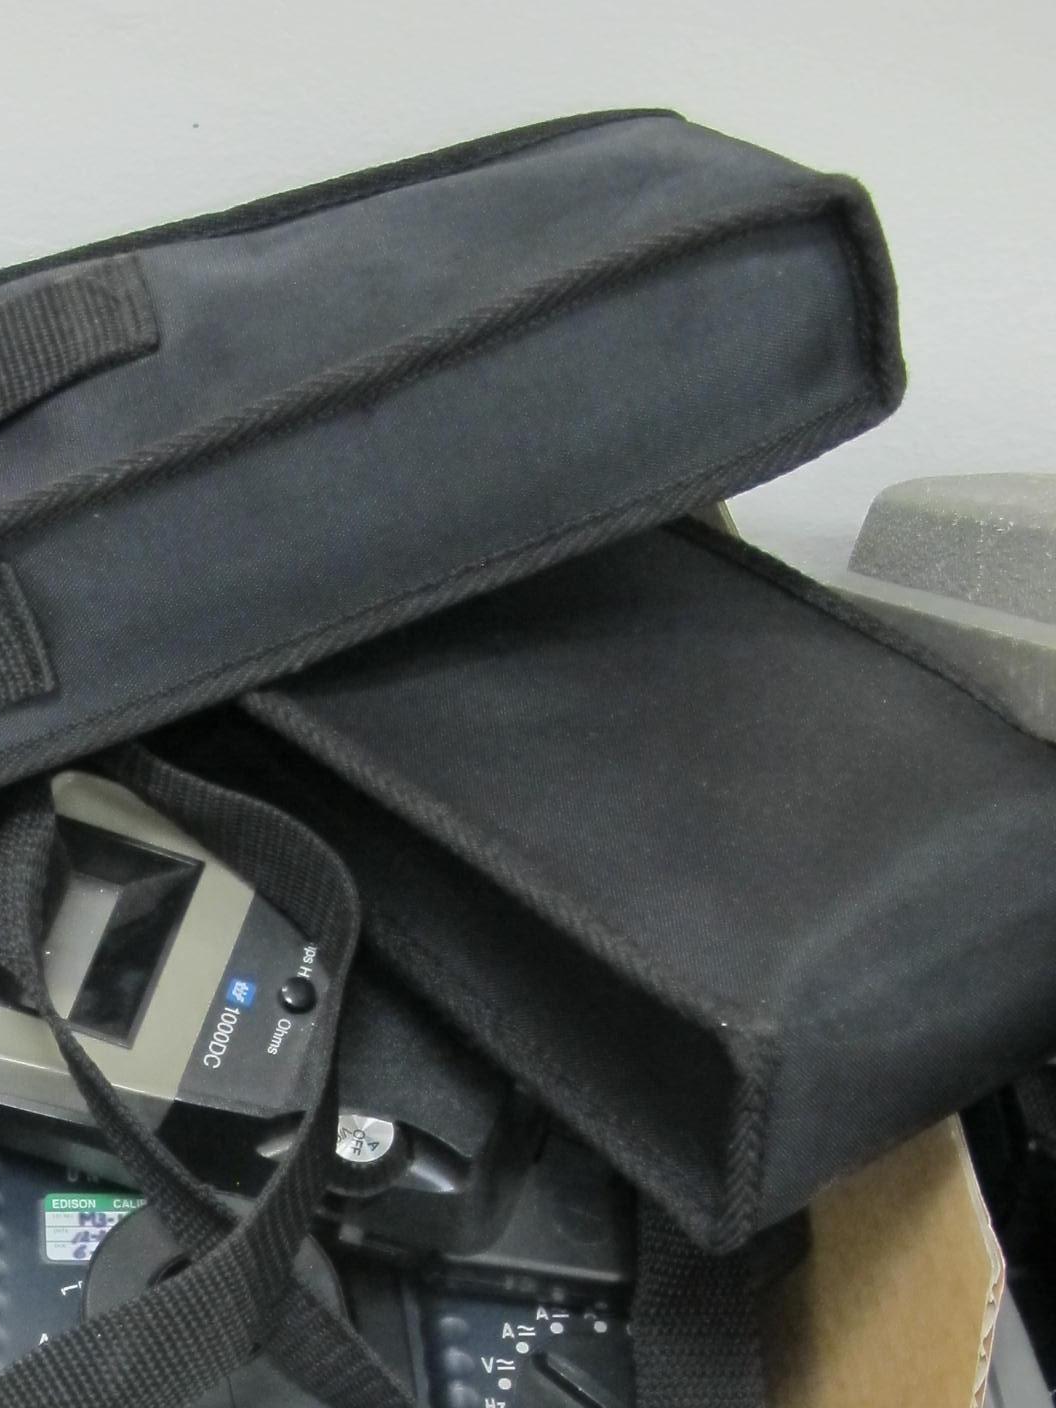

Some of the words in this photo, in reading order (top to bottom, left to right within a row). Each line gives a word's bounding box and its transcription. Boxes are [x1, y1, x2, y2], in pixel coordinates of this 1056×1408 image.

[203, 1006, 241, 1070] 1000DC
[267, 1018, 292, 1056] Ohms
[51, 1199, 97, 1209] EDISON
